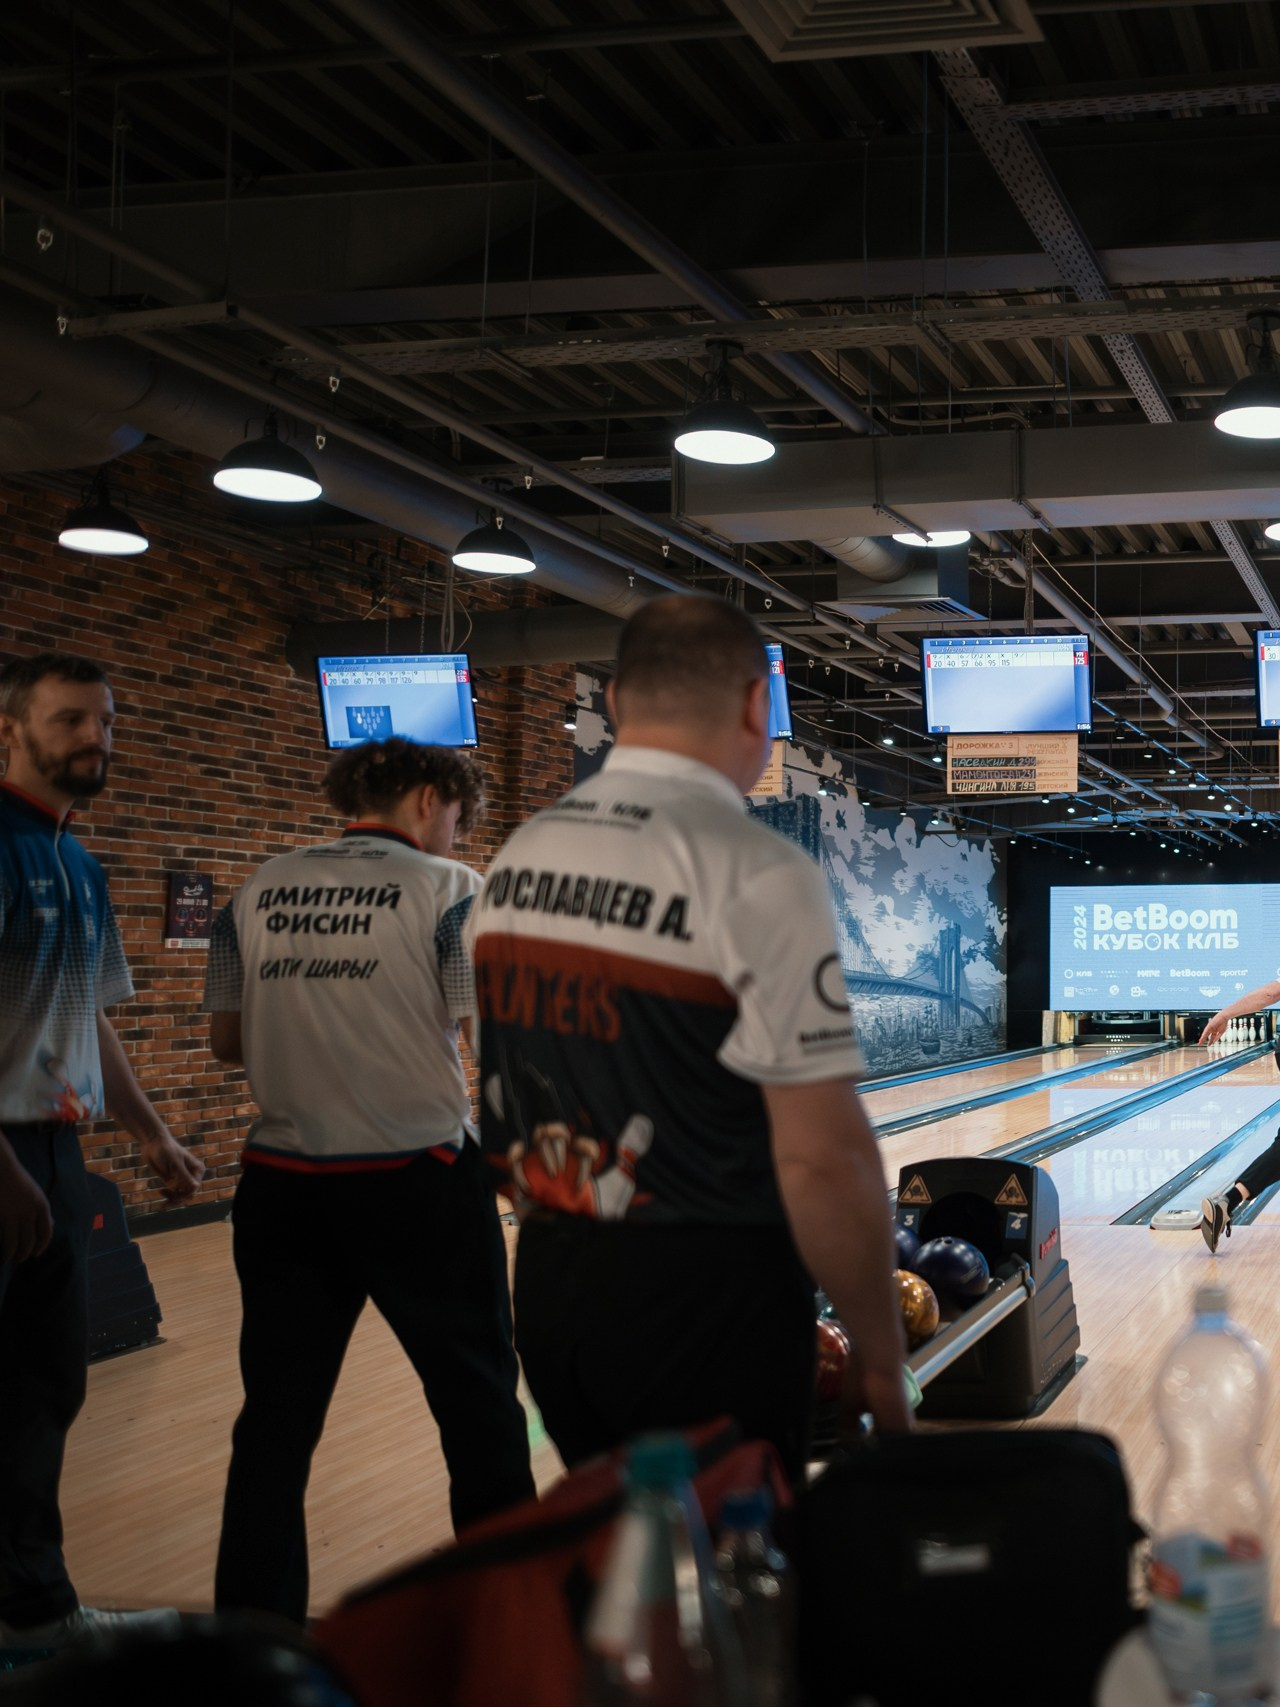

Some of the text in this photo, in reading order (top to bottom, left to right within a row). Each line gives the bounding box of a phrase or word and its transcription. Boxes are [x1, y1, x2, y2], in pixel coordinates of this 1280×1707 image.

[956, 742, 1001, 750] ДОРОЖКА
[256, 882, 402, 913] ДМИТРИЙ
[266, 912, 372, 935] ФИСИН
[1093, 903, 1238, 931] BetBoom
[1073, 904, 1087, 951] 2024
[1093, 932, 1239, 951] КУБОК КЛБ
[305, 958, 380, 980] ШАРЫ!
[1170, 969, 1210, 977] BetBoom
[903, 1214, 914, 1227] 3
[1010, 1218, 1022, 1230] 4
